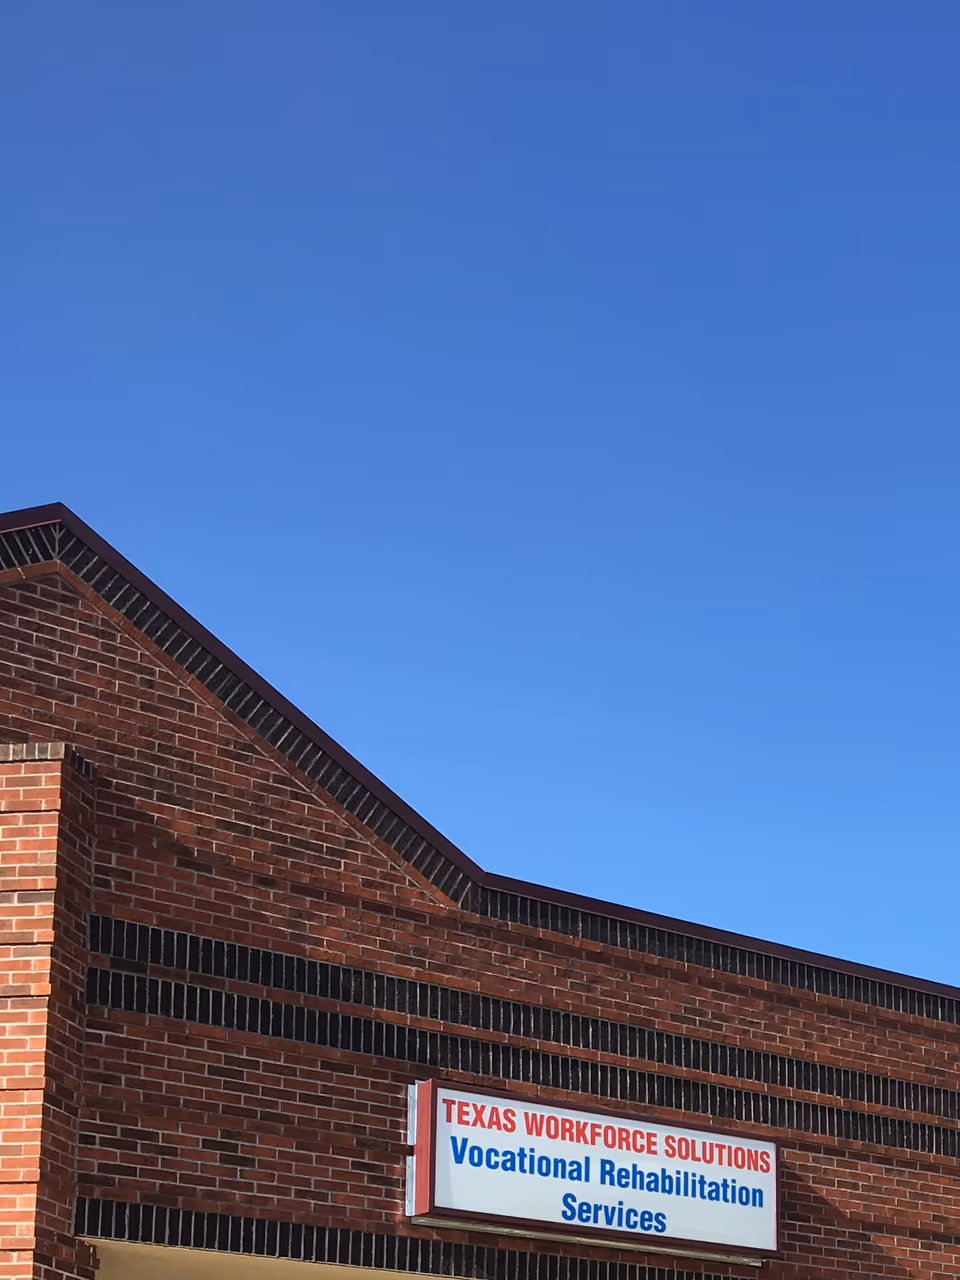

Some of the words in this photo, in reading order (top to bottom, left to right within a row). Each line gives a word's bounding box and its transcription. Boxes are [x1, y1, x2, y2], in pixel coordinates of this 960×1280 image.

[442, 1098, 516, 1133] TEXAS
[524, 1112, 657, 1156] WORKFORCE
[664, 1135, 771, 1174] SOLUTIONS
[450, 1136, 590, 1182] Vocational
[599, 1158, 764, 1208] Rehabilitation
[561, 1193, 667, 1233] Services
